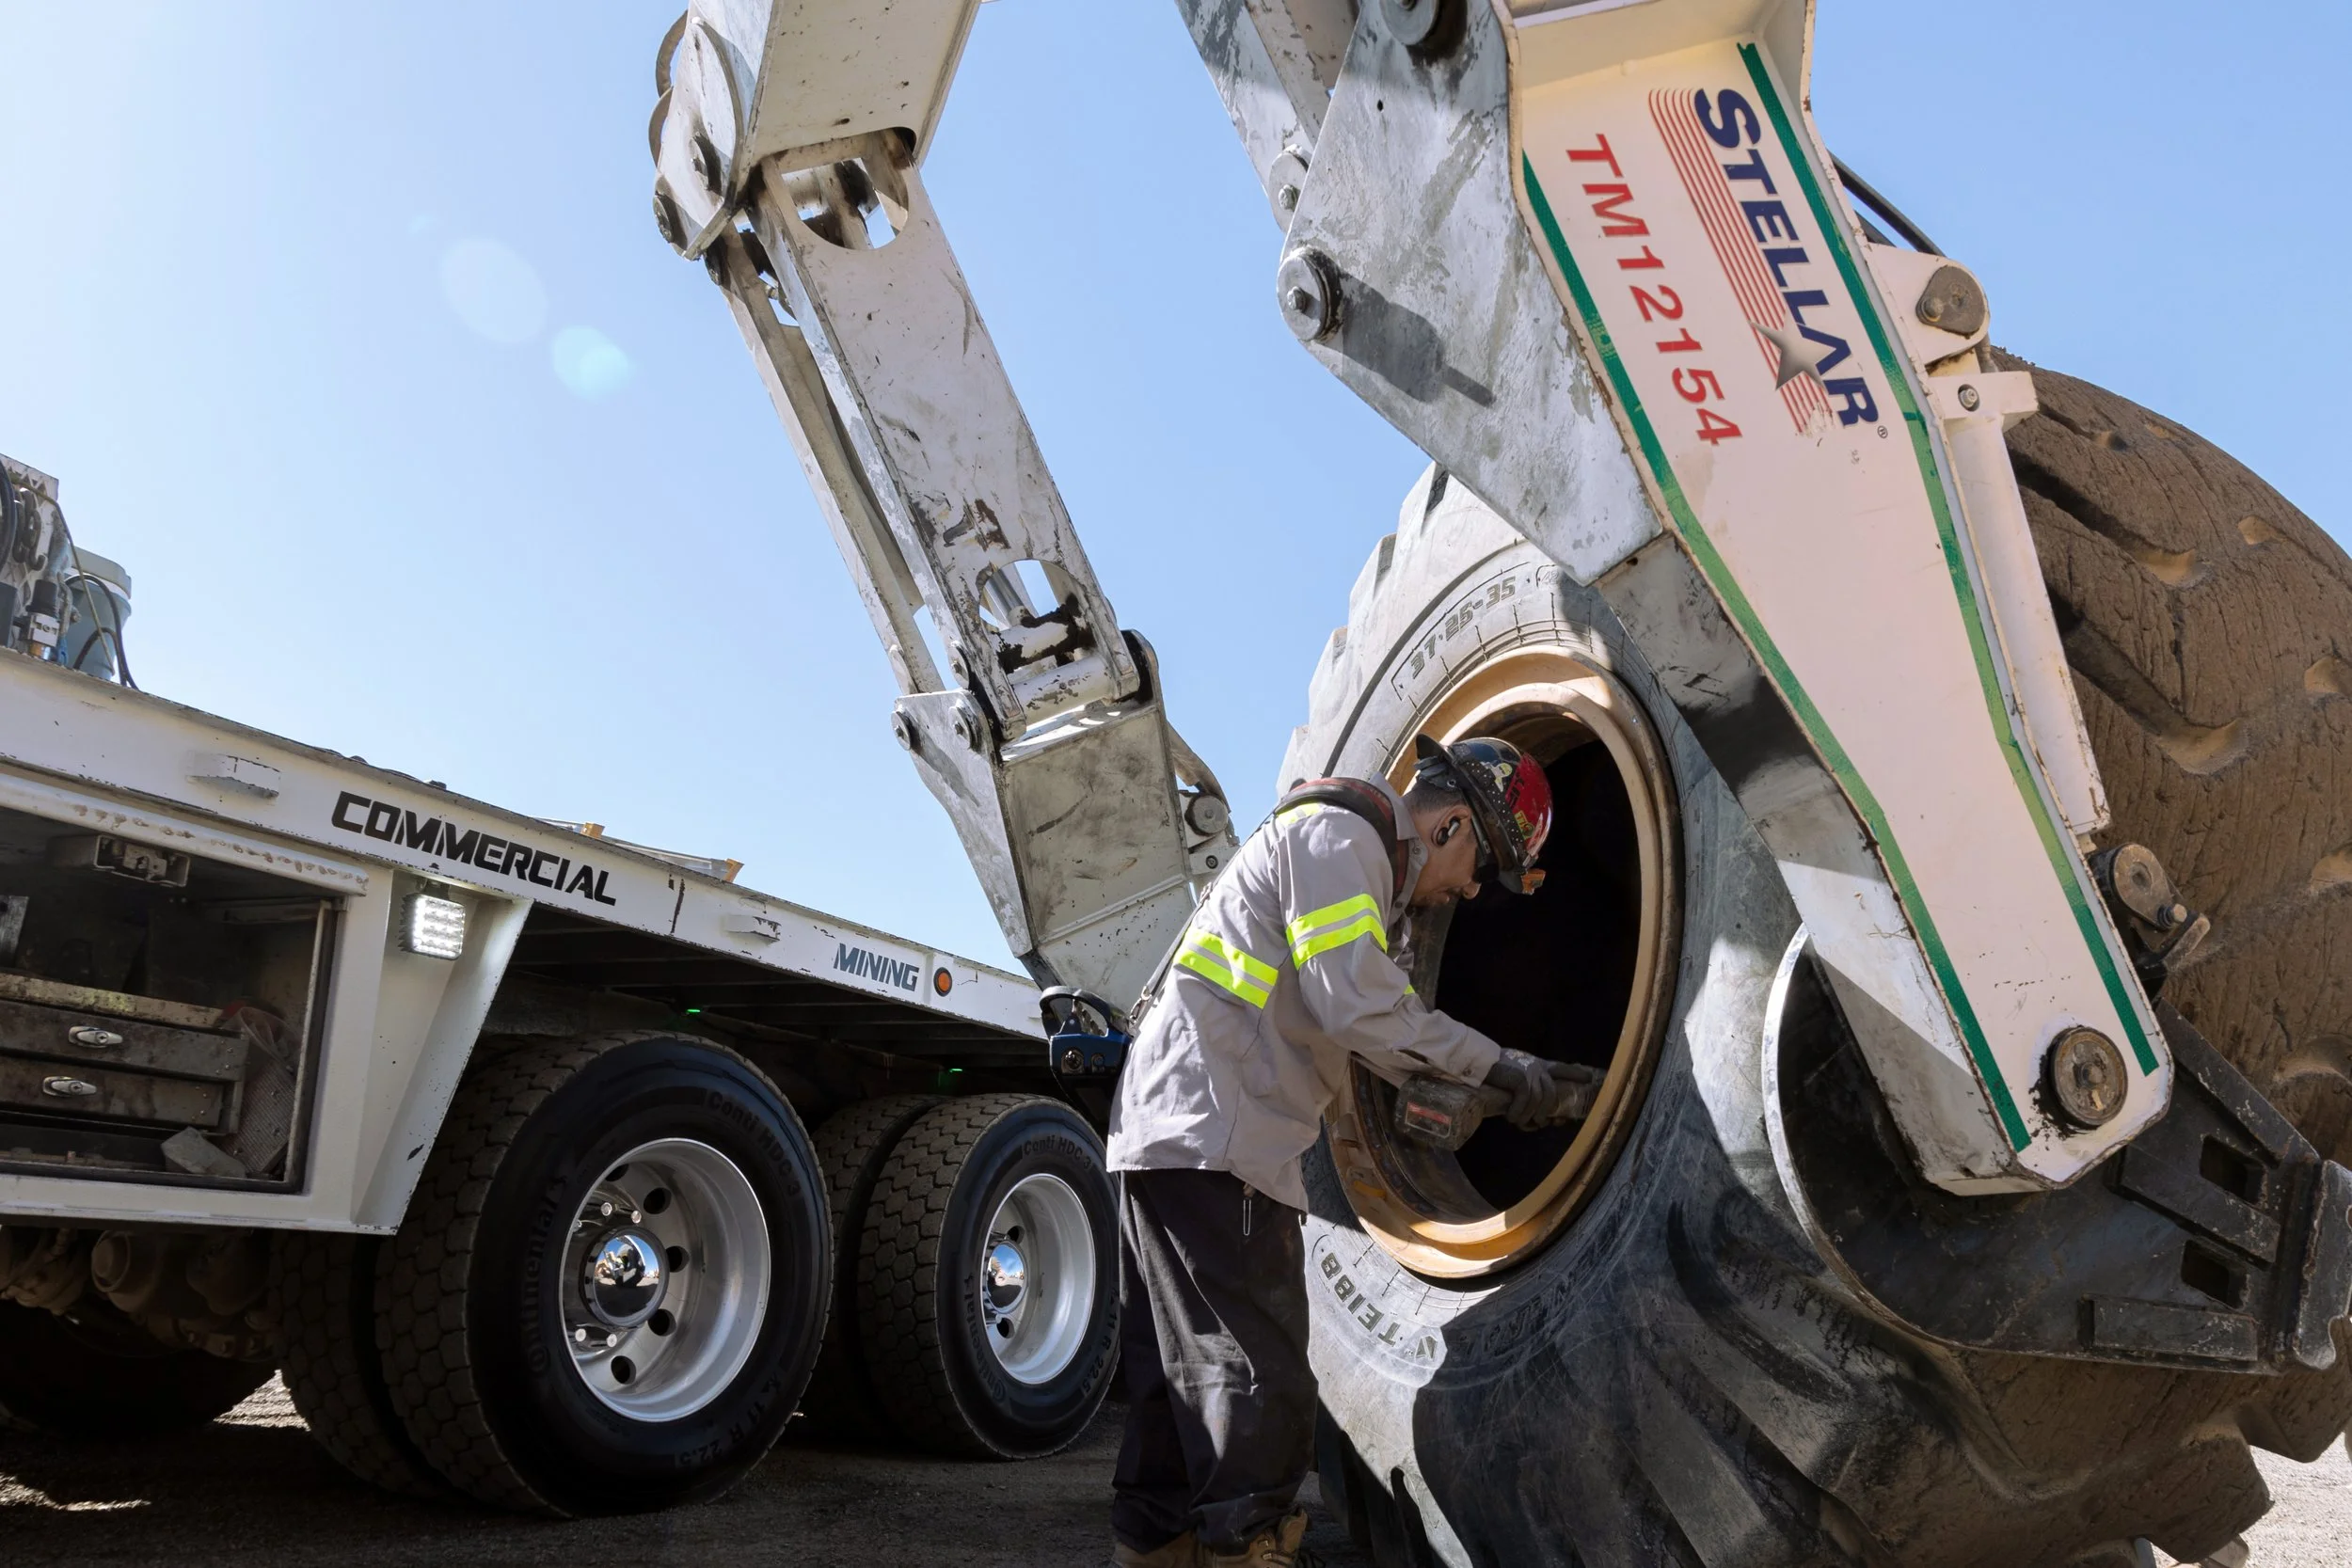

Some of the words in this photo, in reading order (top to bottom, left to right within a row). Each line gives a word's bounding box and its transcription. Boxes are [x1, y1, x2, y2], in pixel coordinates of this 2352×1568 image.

[1565, 134, 1742, 446] TM12154
[1694, 88, 1880, 428] STELLAR
[331, 791, 616, 906] COMMERCIAL
[834, 942, 920, 992] MINING
[709, 1091, 760, 1132] Conti
[1057, 1136, 1083, 1160] HDC
